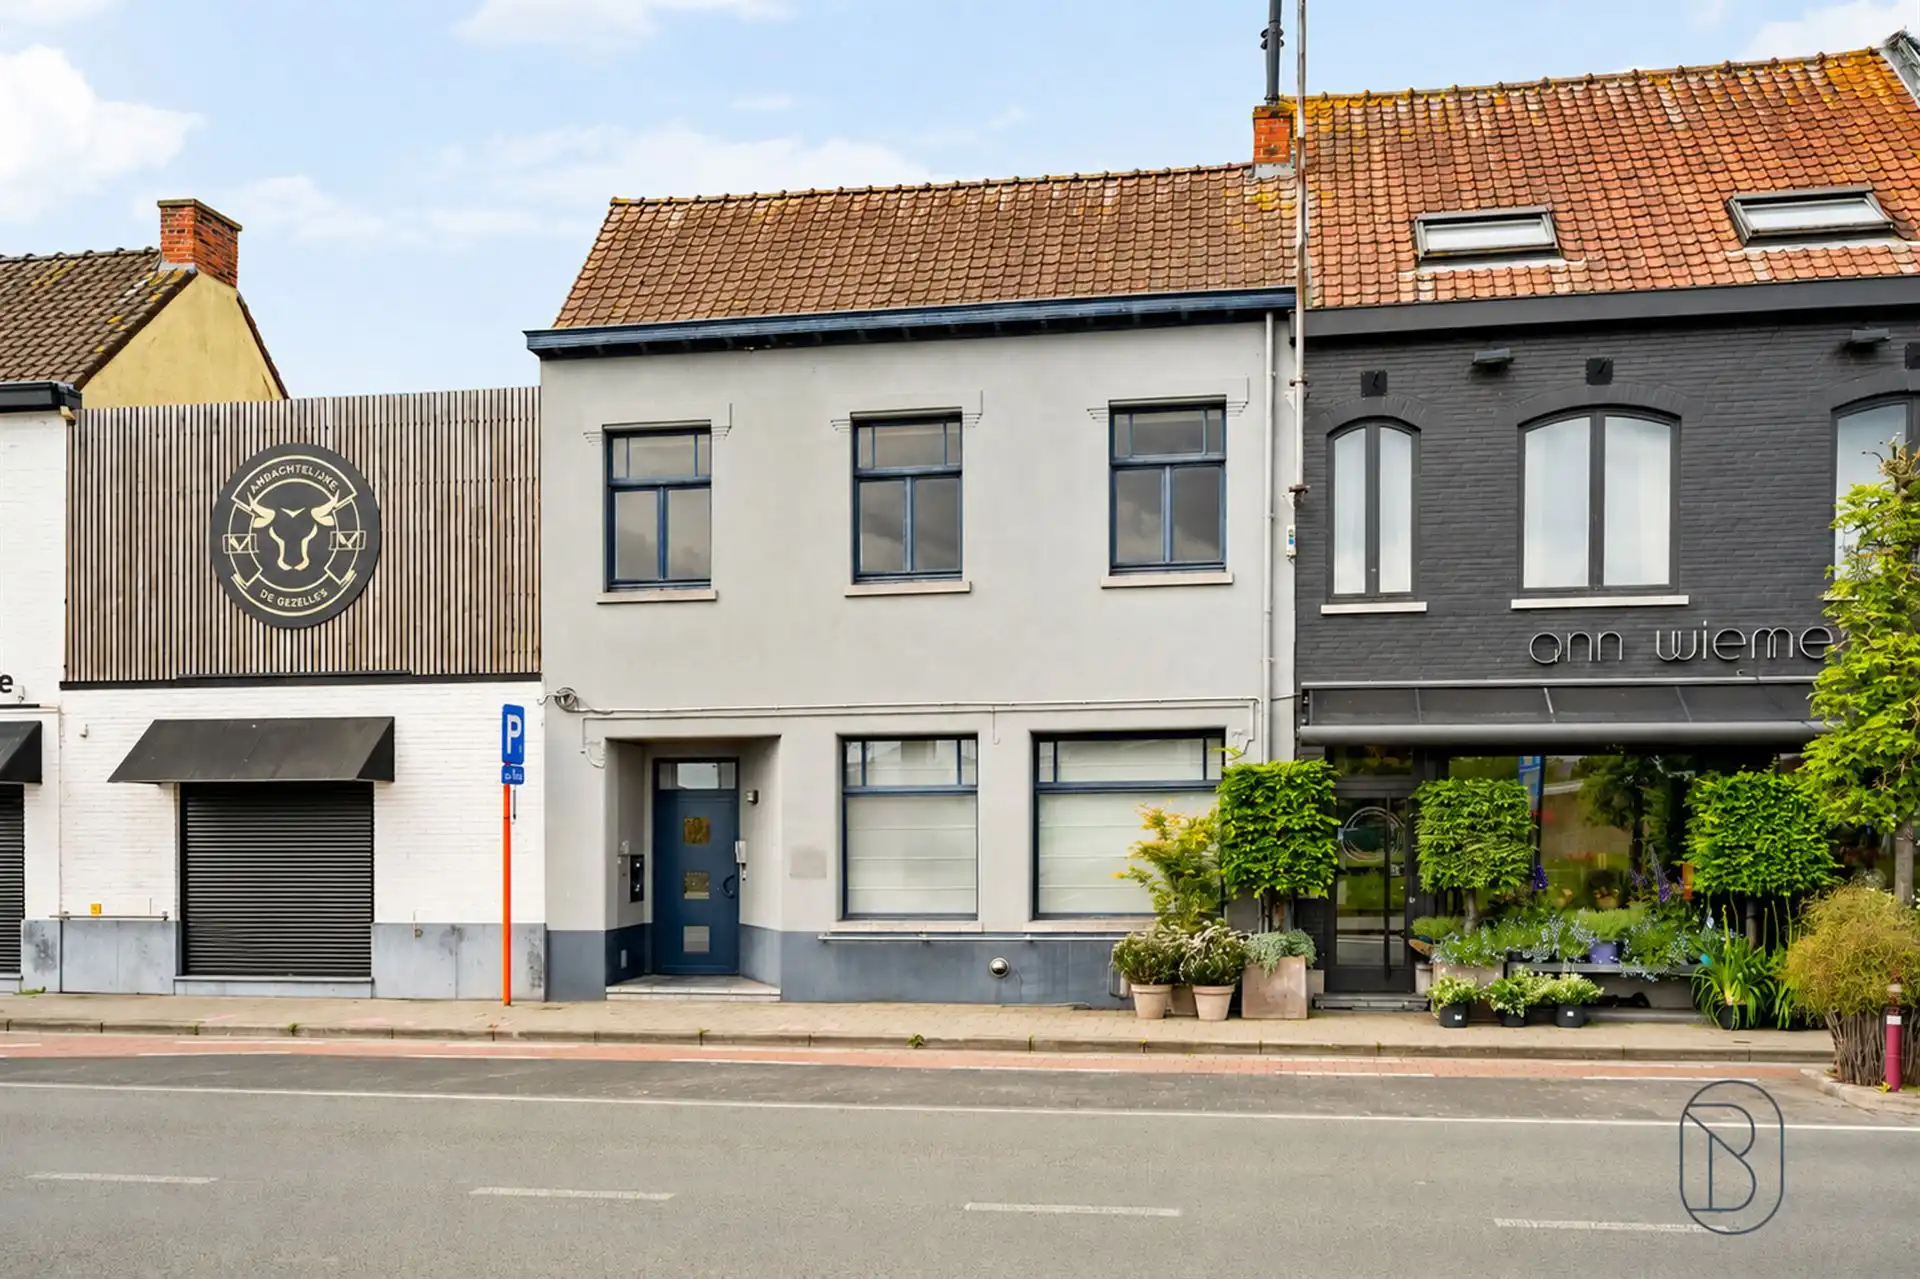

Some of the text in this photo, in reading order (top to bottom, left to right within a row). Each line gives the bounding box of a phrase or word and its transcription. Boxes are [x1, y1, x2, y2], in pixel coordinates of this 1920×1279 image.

[260, 589, 275, 602] DE
[1529, 620, 1834, 664] ann wieme
[507, 714, 522, 754] P
